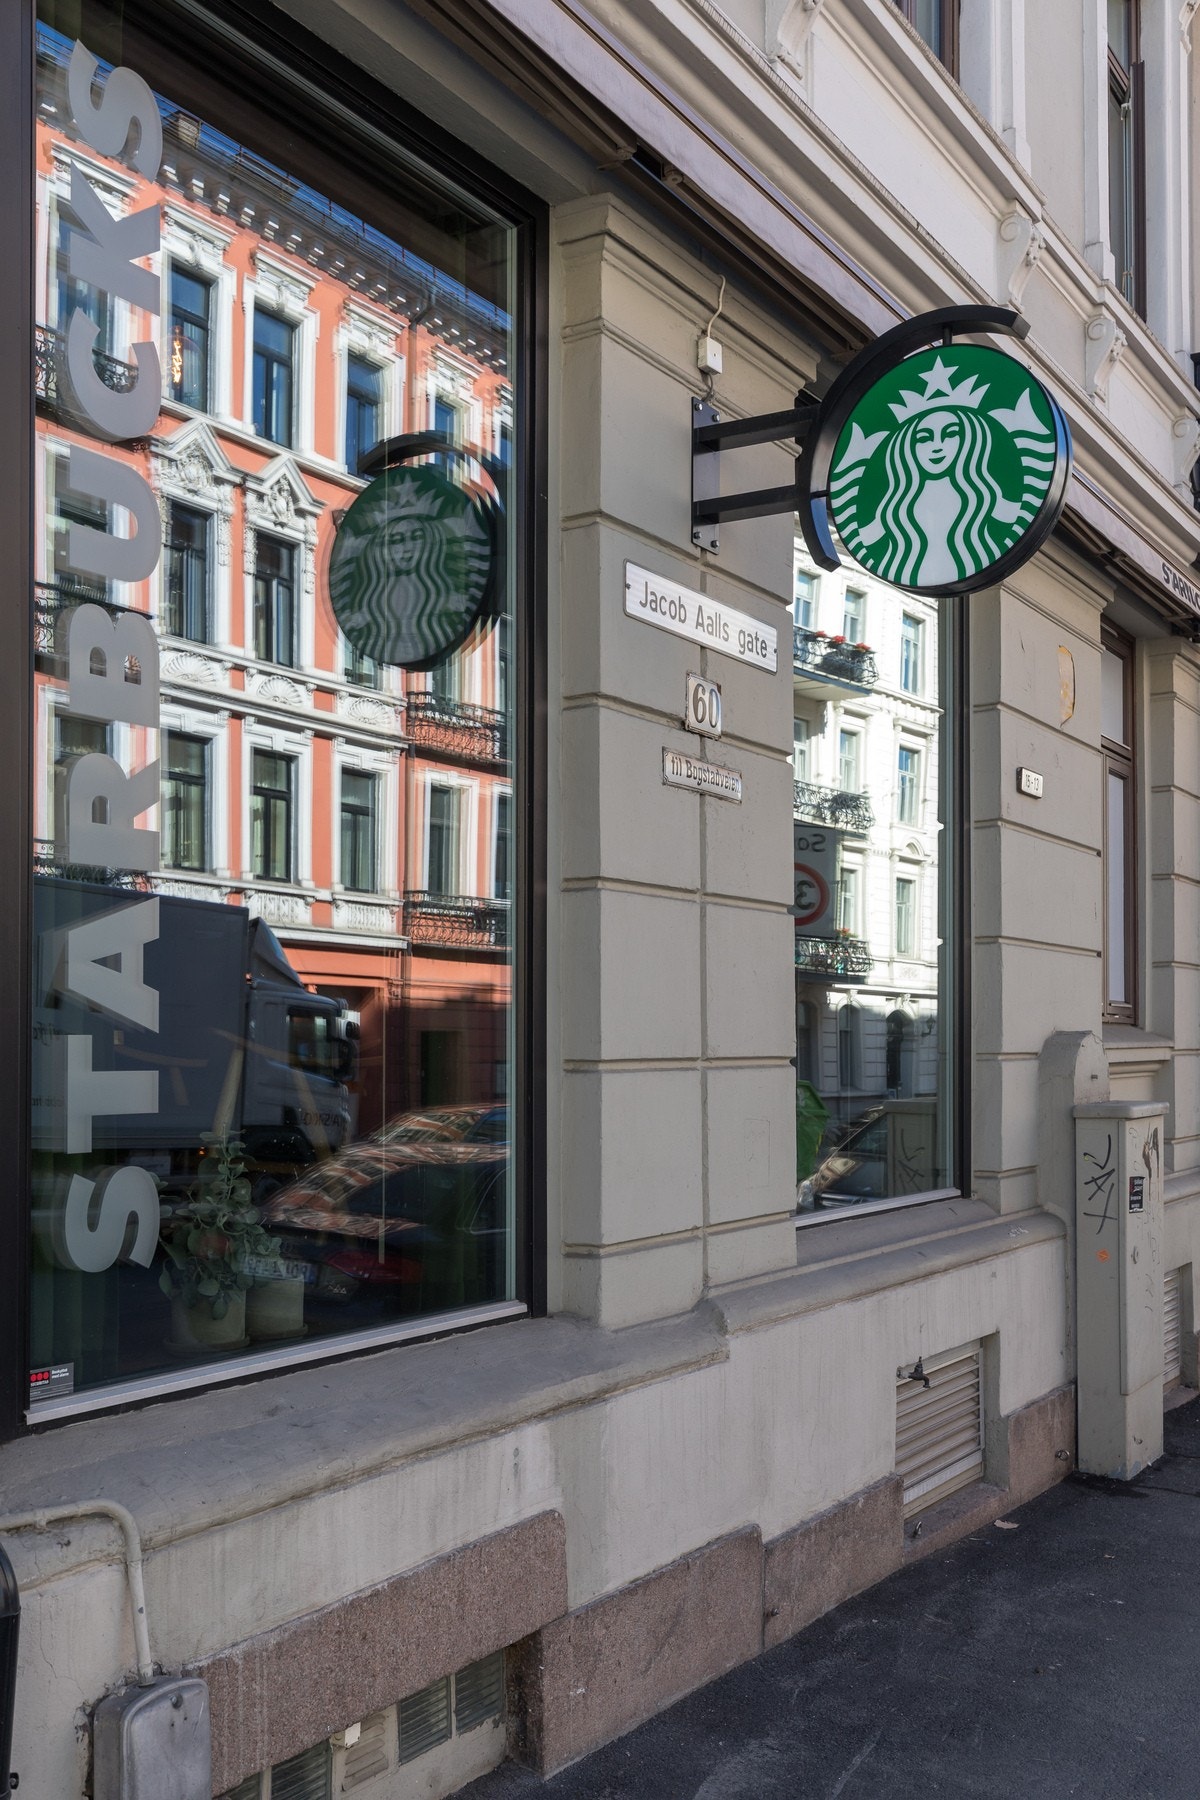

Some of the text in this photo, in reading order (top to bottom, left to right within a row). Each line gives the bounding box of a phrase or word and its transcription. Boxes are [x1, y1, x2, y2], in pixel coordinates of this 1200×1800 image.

[639, 581, 768, 658] Jacob Aalls gate
[65, 38, 163, 1272] STARBUCKS
[692, 683, 720, 728] 60
[671, 756, 682, 777] til
